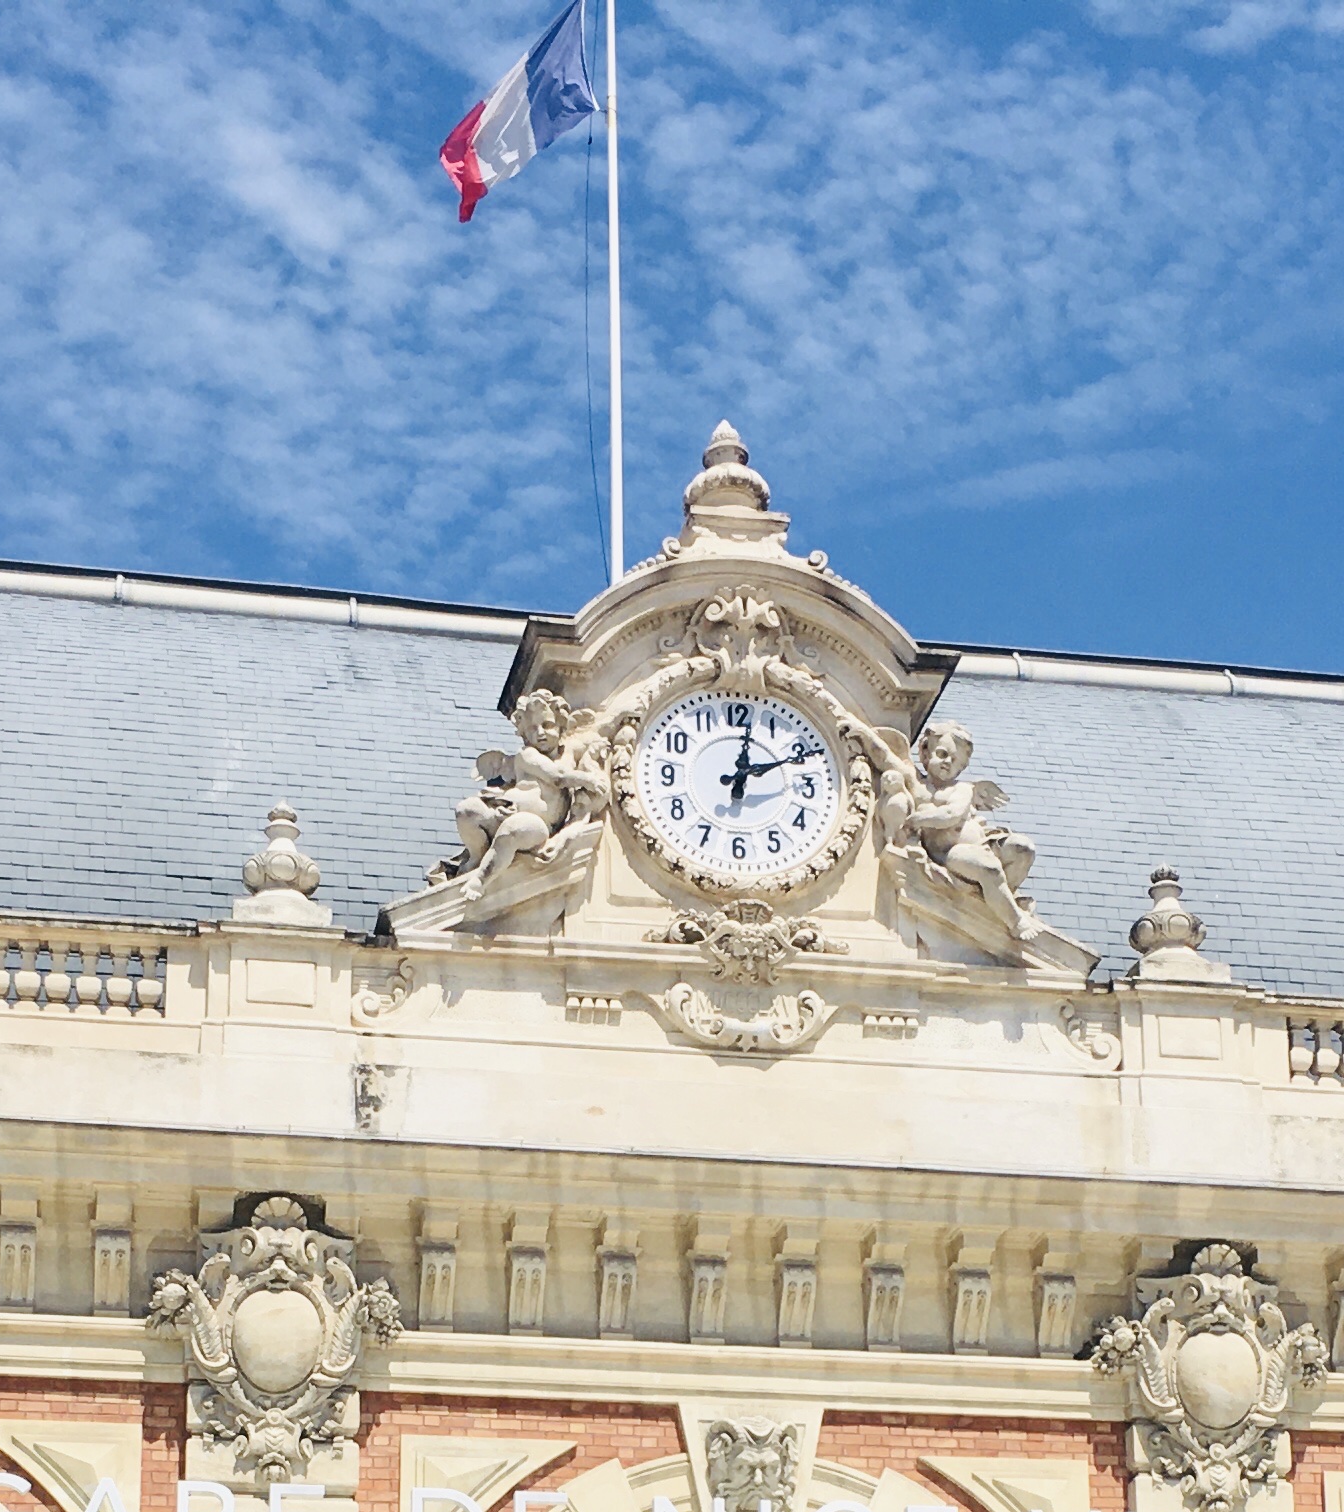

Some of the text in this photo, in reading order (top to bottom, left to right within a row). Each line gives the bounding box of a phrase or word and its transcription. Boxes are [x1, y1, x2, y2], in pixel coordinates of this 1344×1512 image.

[695, 711, 712, 733] 11
[727, 703, 750, 727] 12
[768, 718, 776, 739] 1
[666, 732, 688, 754] 10
[661, 764, 675, 787] 9
[801, 776, 816, 800] 3
[670, 799, 685, 820] 8
[792, 808, 806, 831] 4
[697, 824, 712, 848] 7
[768, 830, 781, 853] 5
[731, 836, 746, 860] 6
